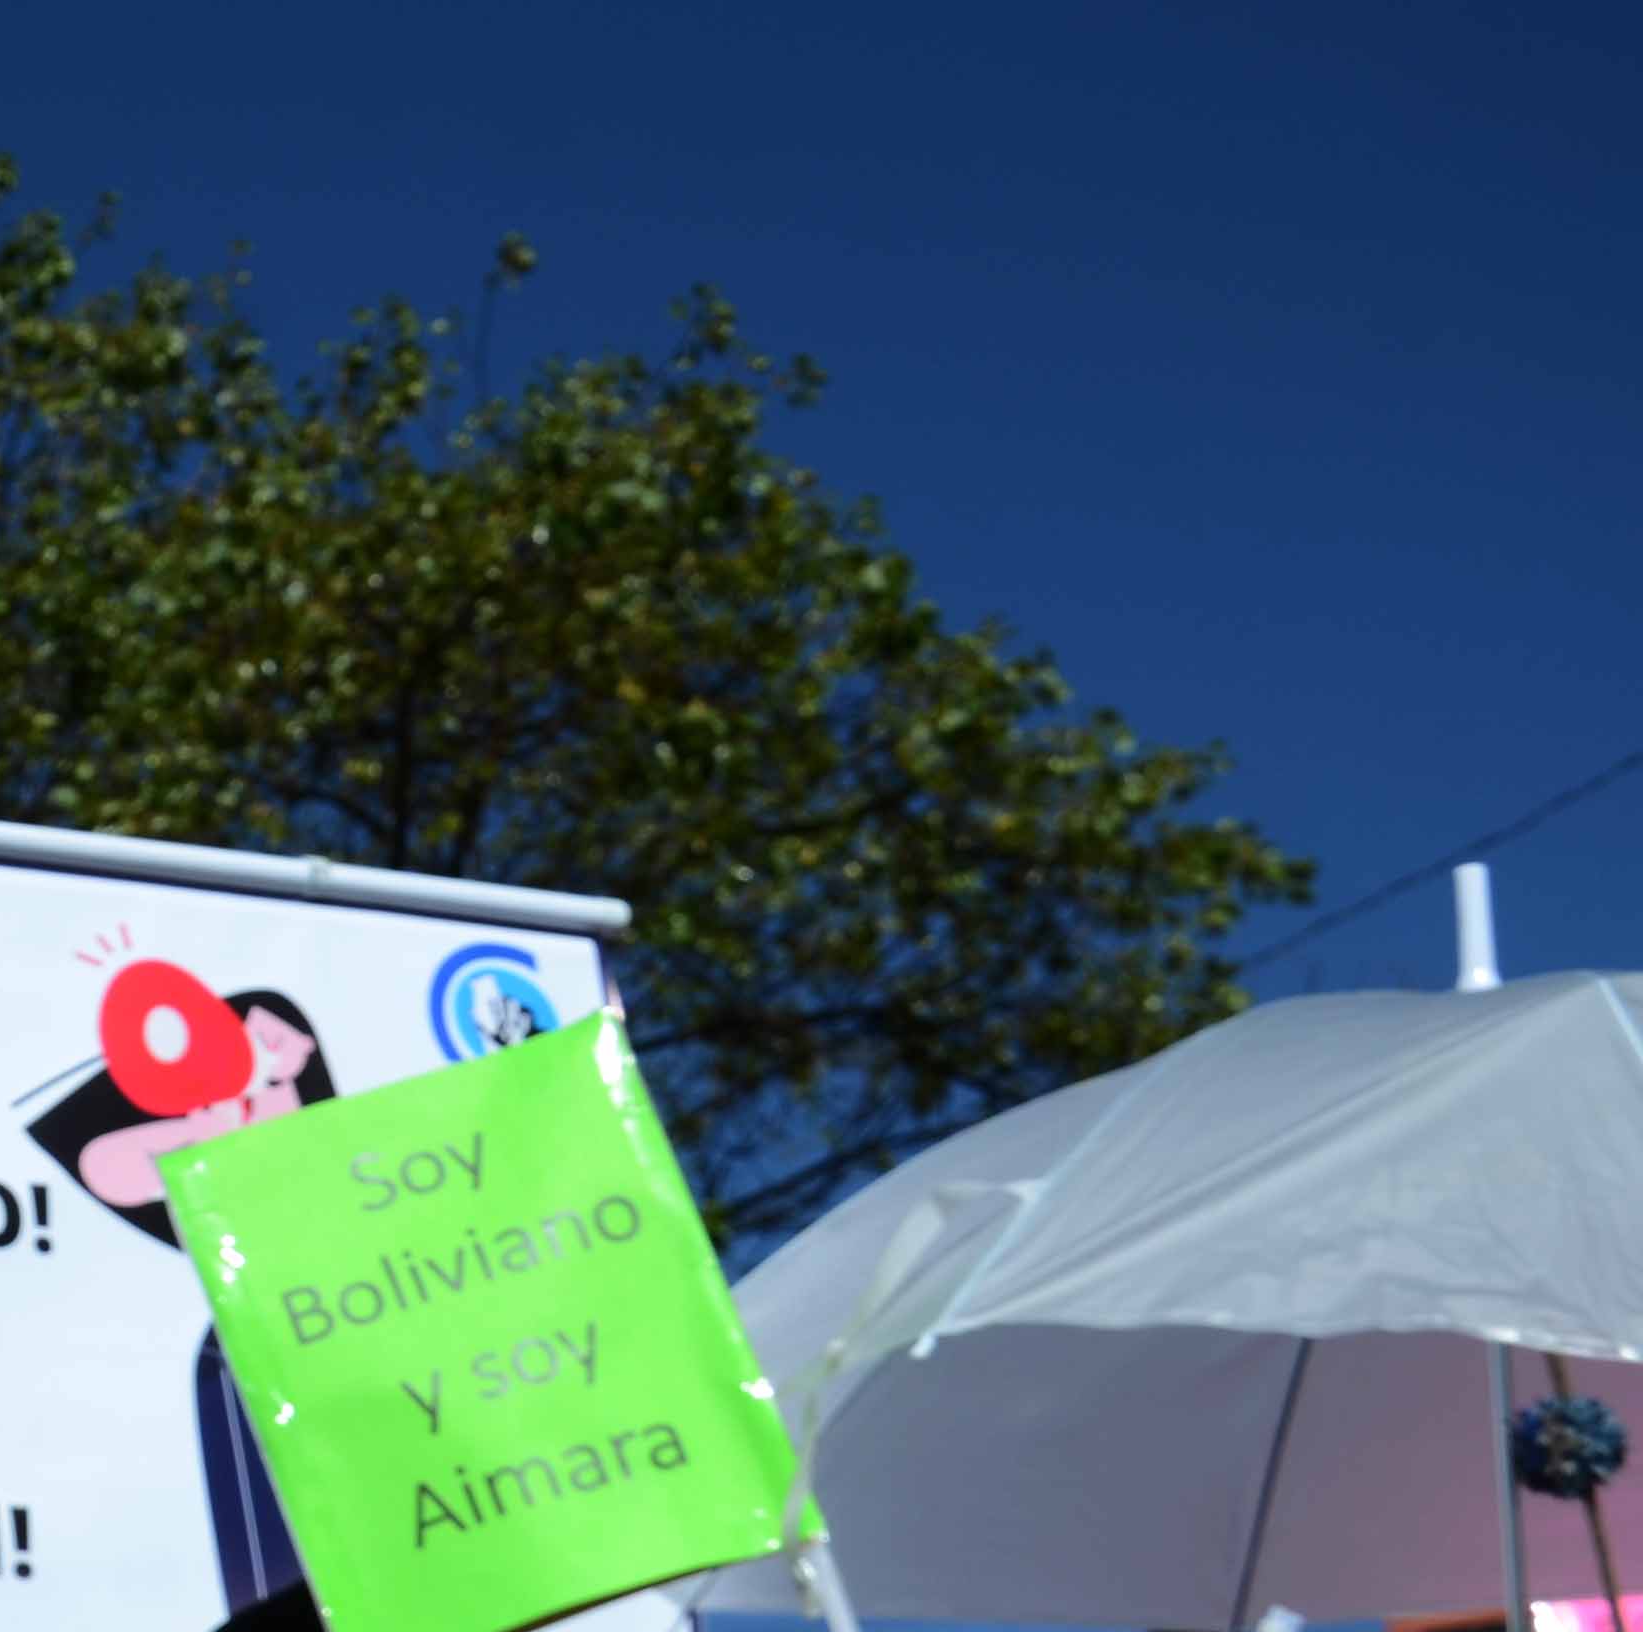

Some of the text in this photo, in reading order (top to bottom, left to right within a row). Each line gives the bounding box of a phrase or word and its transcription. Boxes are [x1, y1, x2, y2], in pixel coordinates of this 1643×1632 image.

[349, 1132, 485, 1212] Soy
[282, 1193, 641, 1346] Boliviano
[472, 1322, 599, 1402] soy
[416, 1420, 689, 1550] Aimara
